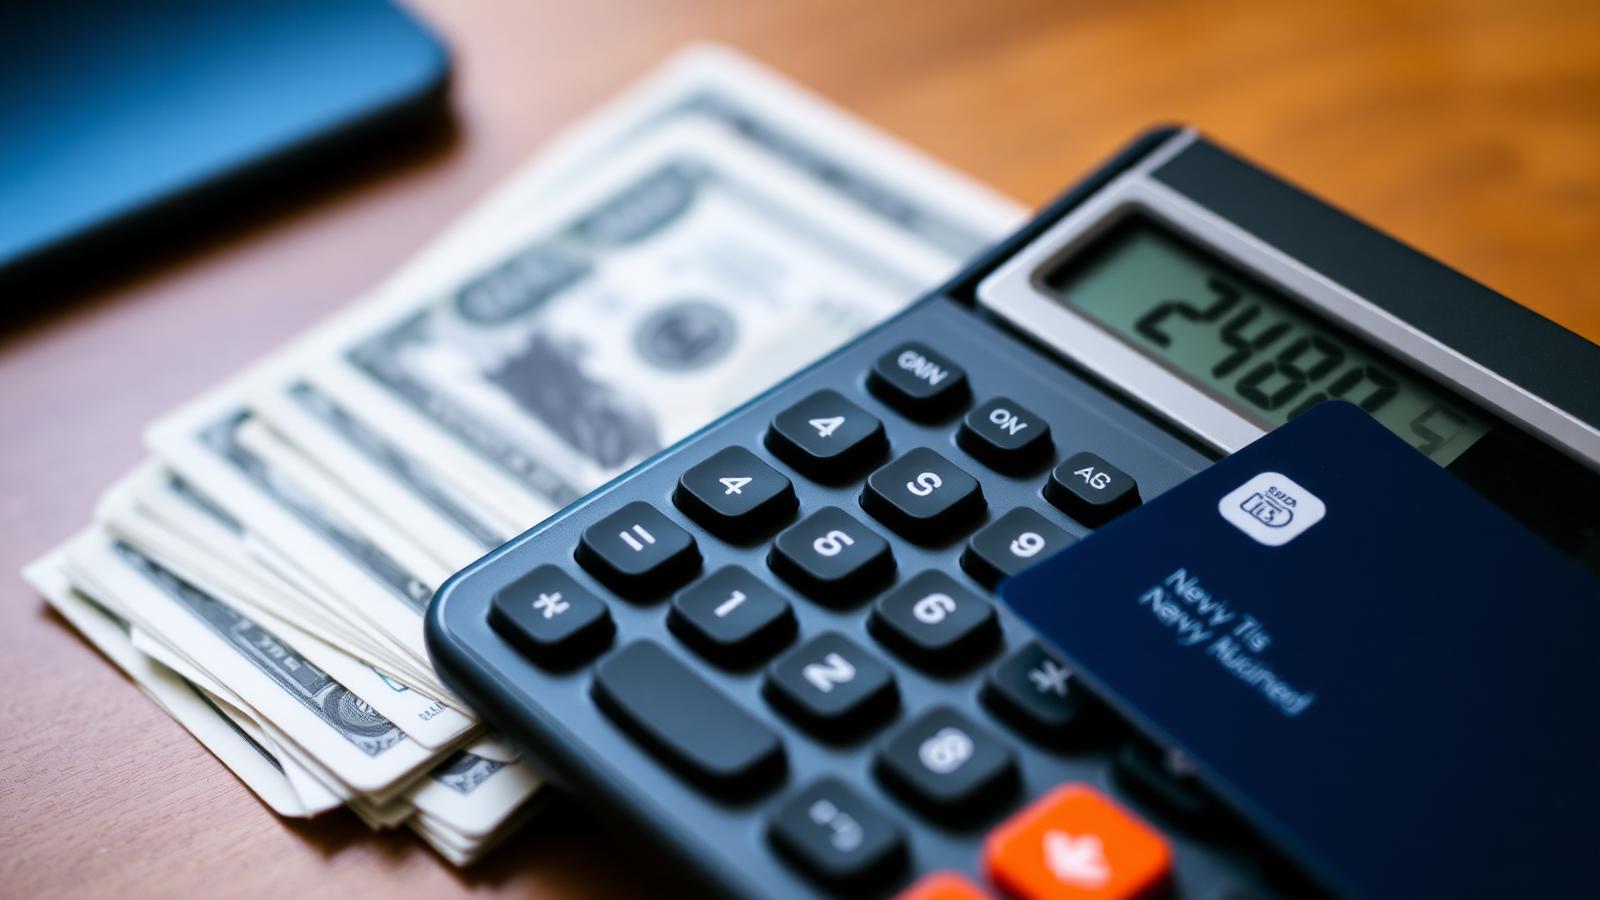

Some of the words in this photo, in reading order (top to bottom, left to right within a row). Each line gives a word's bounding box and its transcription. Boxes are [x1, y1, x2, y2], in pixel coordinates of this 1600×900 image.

[809, 415, 845, 438] 4
[989, 408, 1028, 435] ON
[719, 476, 753, 495] 4
[1009, 532, 1046, 557] 9
[714, 590, 746, 617] 1
[913, 592, 956, 624] 6
